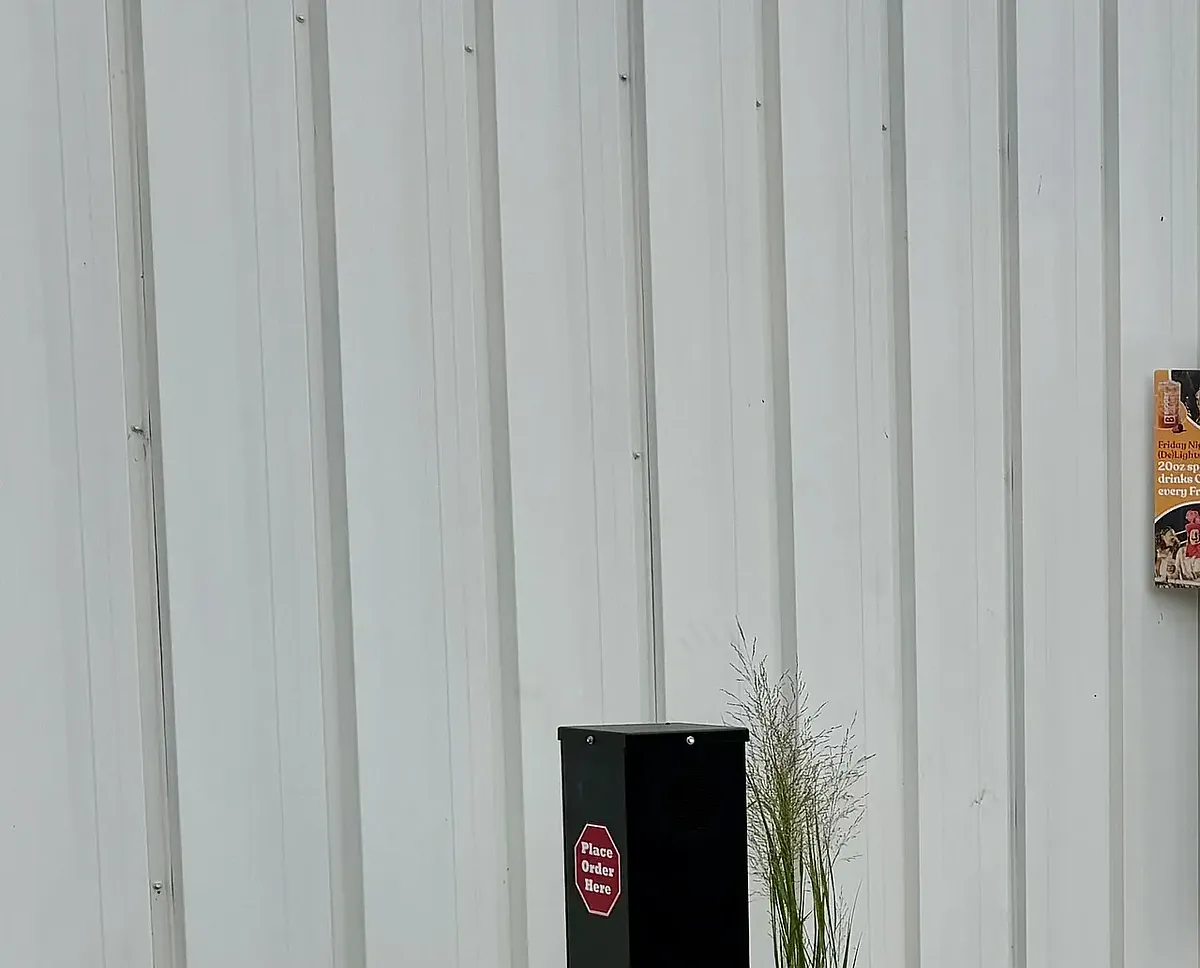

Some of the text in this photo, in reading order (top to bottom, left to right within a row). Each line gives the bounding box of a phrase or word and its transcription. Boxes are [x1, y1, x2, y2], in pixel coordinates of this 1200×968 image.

[1158, 441, 1186, 449] Friday
[1158, 461, 1186, 471] 20oz
[1158, 474, 1193, 483] drinks
[1158, 488, 1187, 497] every
[581, 841, 613, 858] Place
[581, 860, 614, 877] Order
[585, 879, 611, 895] Here
